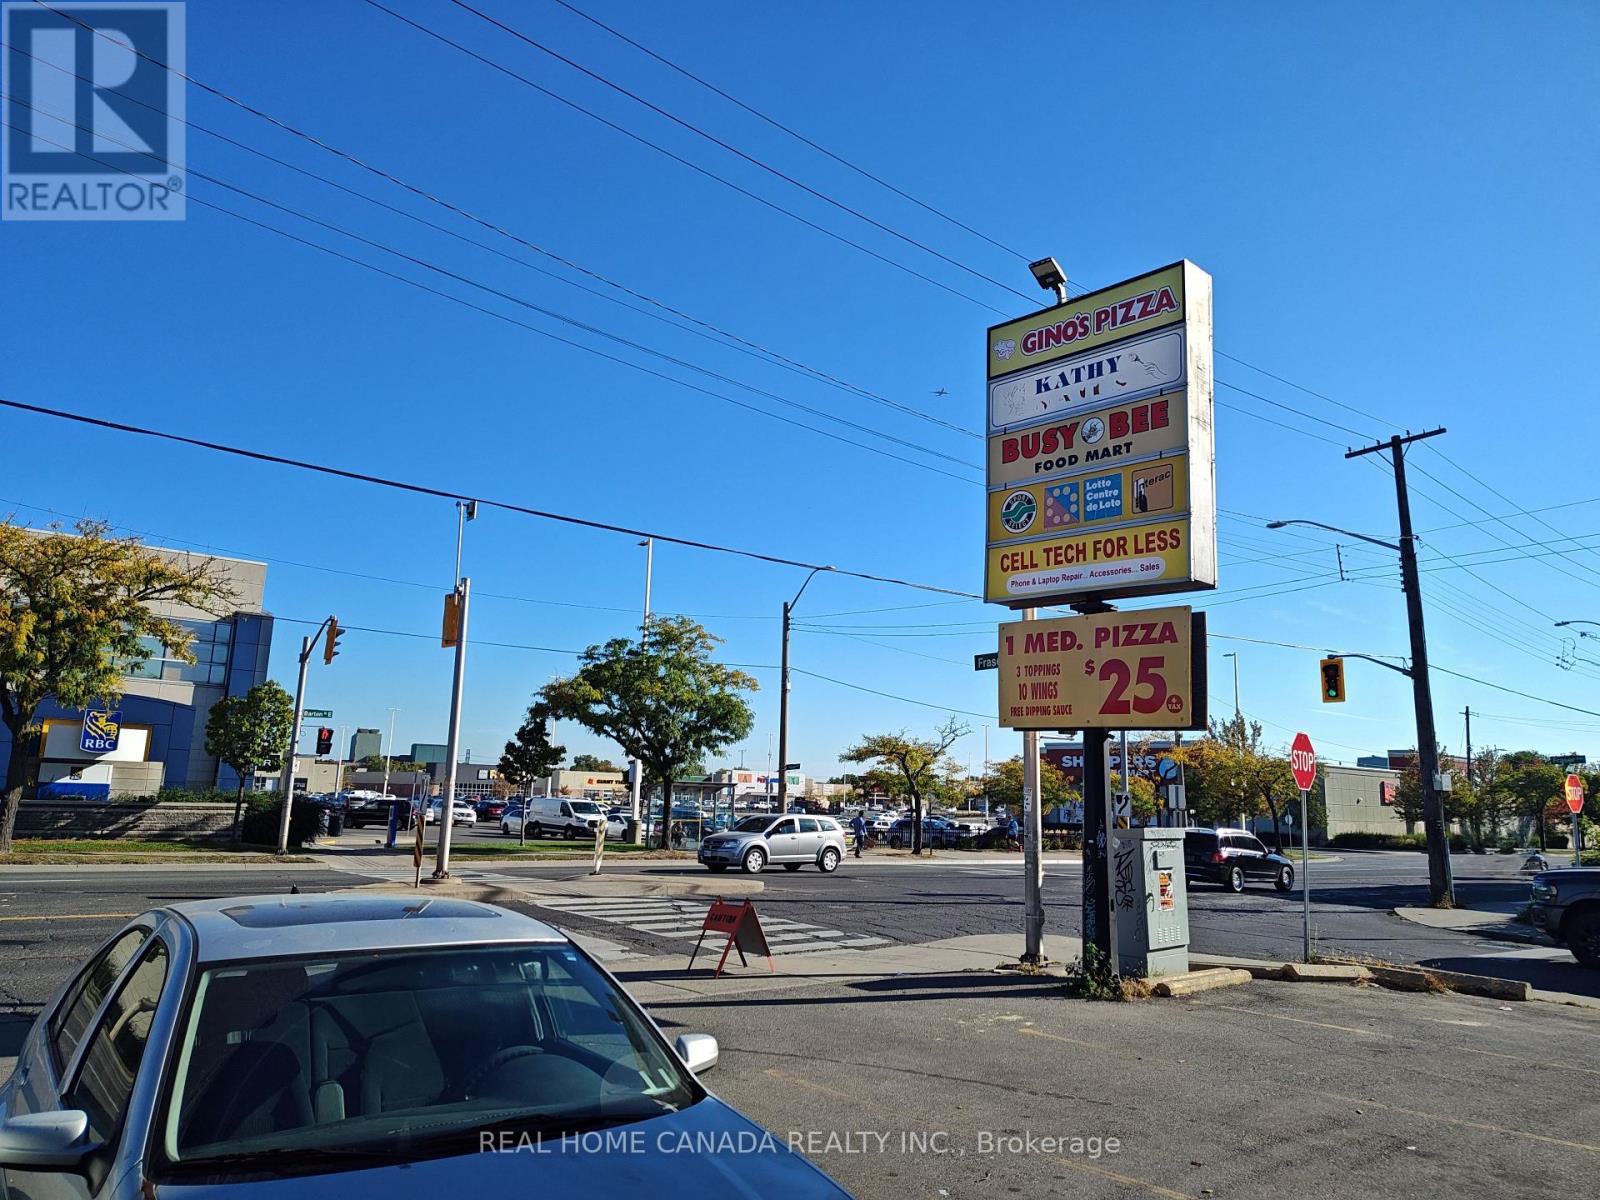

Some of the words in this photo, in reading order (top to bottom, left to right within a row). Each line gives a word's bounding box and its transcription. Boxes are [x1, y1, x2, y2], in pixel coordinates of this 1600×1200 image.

[1021, 313, 1091, 354] GINO'S
[1095, 287, 1177, 333] PIZZA
[1035, 355, 1122, 395] KATHY
[1002, 421, 1080, 464] BUSY
[1109, 399, 1169, 440] BEE
[1034, 454, 1078, 474] FOOD
[1085, 441, 1133, 463] MART
[1086, 480, 1111, 490] Lotto
[1086, 489, 1119, 501] Centre
[1086, 502, 1098, 511] de
[1100, 499, 1121, 510] Loto
[1000, 550, 1038, 573] CELL
[1043, 541, 1087, 566] TECH
[1093, 536, 1128, 561] FOR
[1134, 528, 1181, 555] LESS
[1010, 580, 1030, 588] Phone
[1032, 577, 1037, 585] &
[1038, 576, 1060, 586] Laptop
[1139, 562, 1160, 572] Sales
[1006, 635, 1014, 656] 1
[1024, 630, 1084, 654] MED.
[1095, 621, 1178, 649] PIZZA
[978, 656, 999, 668] Fras
[1016, 665, 1021, 678] 3
[1024, 663, 1061, 676] TOPPINGS
[1018, 684, 1027, 701] 10
[1031, 682, 1058, 700] WINGS
[1010, 706, 1024, 716] FREE
[1025, 704, 1051, 716] DIPPING
[1052, 704, 1072, 716] SAUCE
[85, 739, 115, 749] RBC
[1293, 750, 1314, 772] STOP
[1567, 786, 1582, 801] STOP
